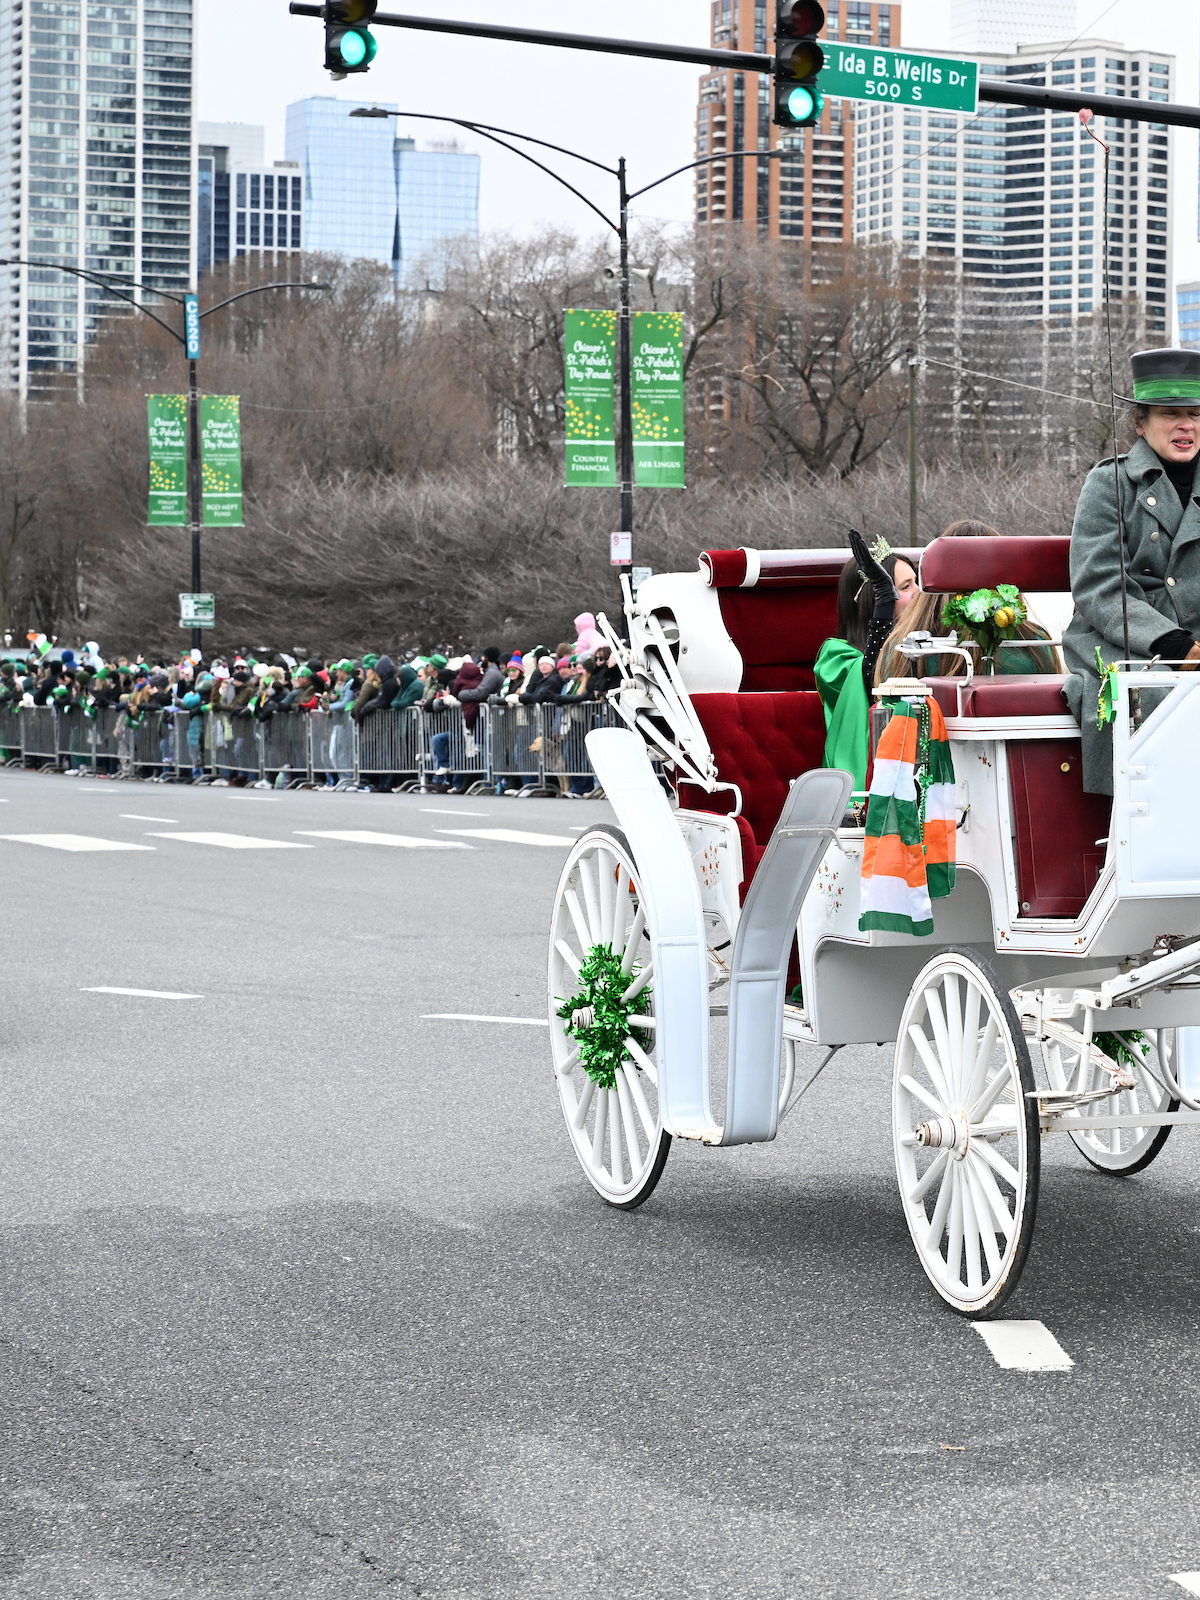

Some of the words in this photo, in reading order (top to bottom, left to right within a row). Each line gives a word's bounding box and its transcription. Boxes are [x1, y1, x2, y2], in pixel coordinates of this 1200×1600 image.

[838, 51, 866, 75] Ida
[873, 55, 890, 78] B.
[894, 58, 942, 84] Wells
[949, 70, 968, 87] Dr
[865, 80, 901, 98] 500
[911, 86, 922, 100] S
[186, 300, 199, 353] C520
[573, 340, 607, 356] Chicago's
[640, 342, 674, 358] Chicago's
[566, 353, 579, 366] St.
[579, 353, 612, 367] Patrick's
[633, 356, 645, 368] St.
[645, 355, 681, 368] Patrick's
[568, 366, 584, 382] Day
[584, 367, 612, 380] Parade
[634, 369, 651, 384] Day
[652, 369, 681, 381] Parade
[572, 455, 608, 463] COUNTRY
[638, 460, 653, 468] AER
[654, 460, 681, 469] LINGUS
[571, 463, 610, 472] FINANCIAL
